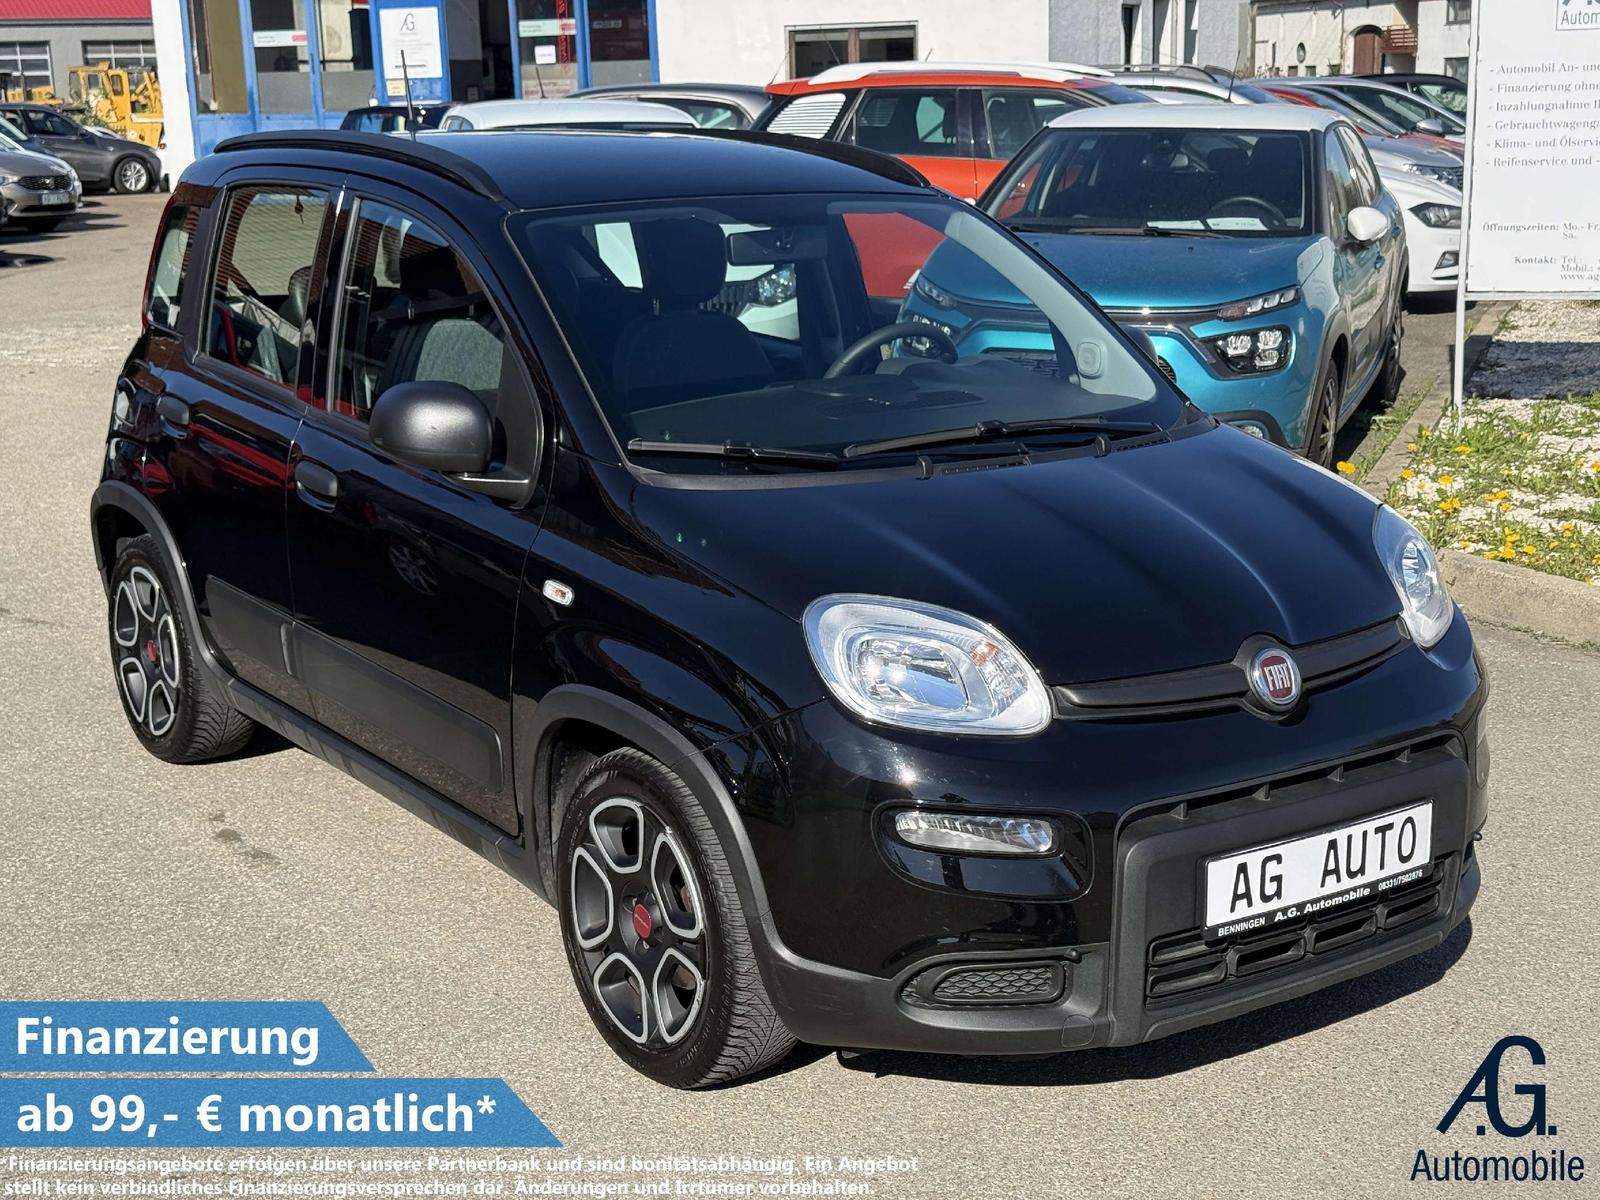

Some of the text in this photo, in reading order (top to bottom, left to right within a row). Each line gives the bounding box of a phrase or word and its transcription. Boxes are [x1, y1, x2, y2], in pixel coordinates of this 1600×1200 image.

[1497, 64, 1555, 75] Automobil
[1558, 63, 1579, 73] An-
[1497, 83, 1571, 93] Finanzierung
[1496, 100, 1590, 112] Inzahlungnahme
[1494, 139, 1531, 149] Klima-
[1535, 138, 1556, 148] und
[1494, 156, 1592, 167] Reifenservice und
[1483, 222, 1559, 232] Öffnungszeiten:
[1514, 256, 1556, 264] Kontakt:
[1264, 663, 1291, 691] FIAT
[1230, 816, 1417, 914] AG AUTO
[1218, 917, 1266, 937] BENNINGEN
[1274, 908, 1301, 922] A.G.
[1304, 887, 1370, 912] Automobile
